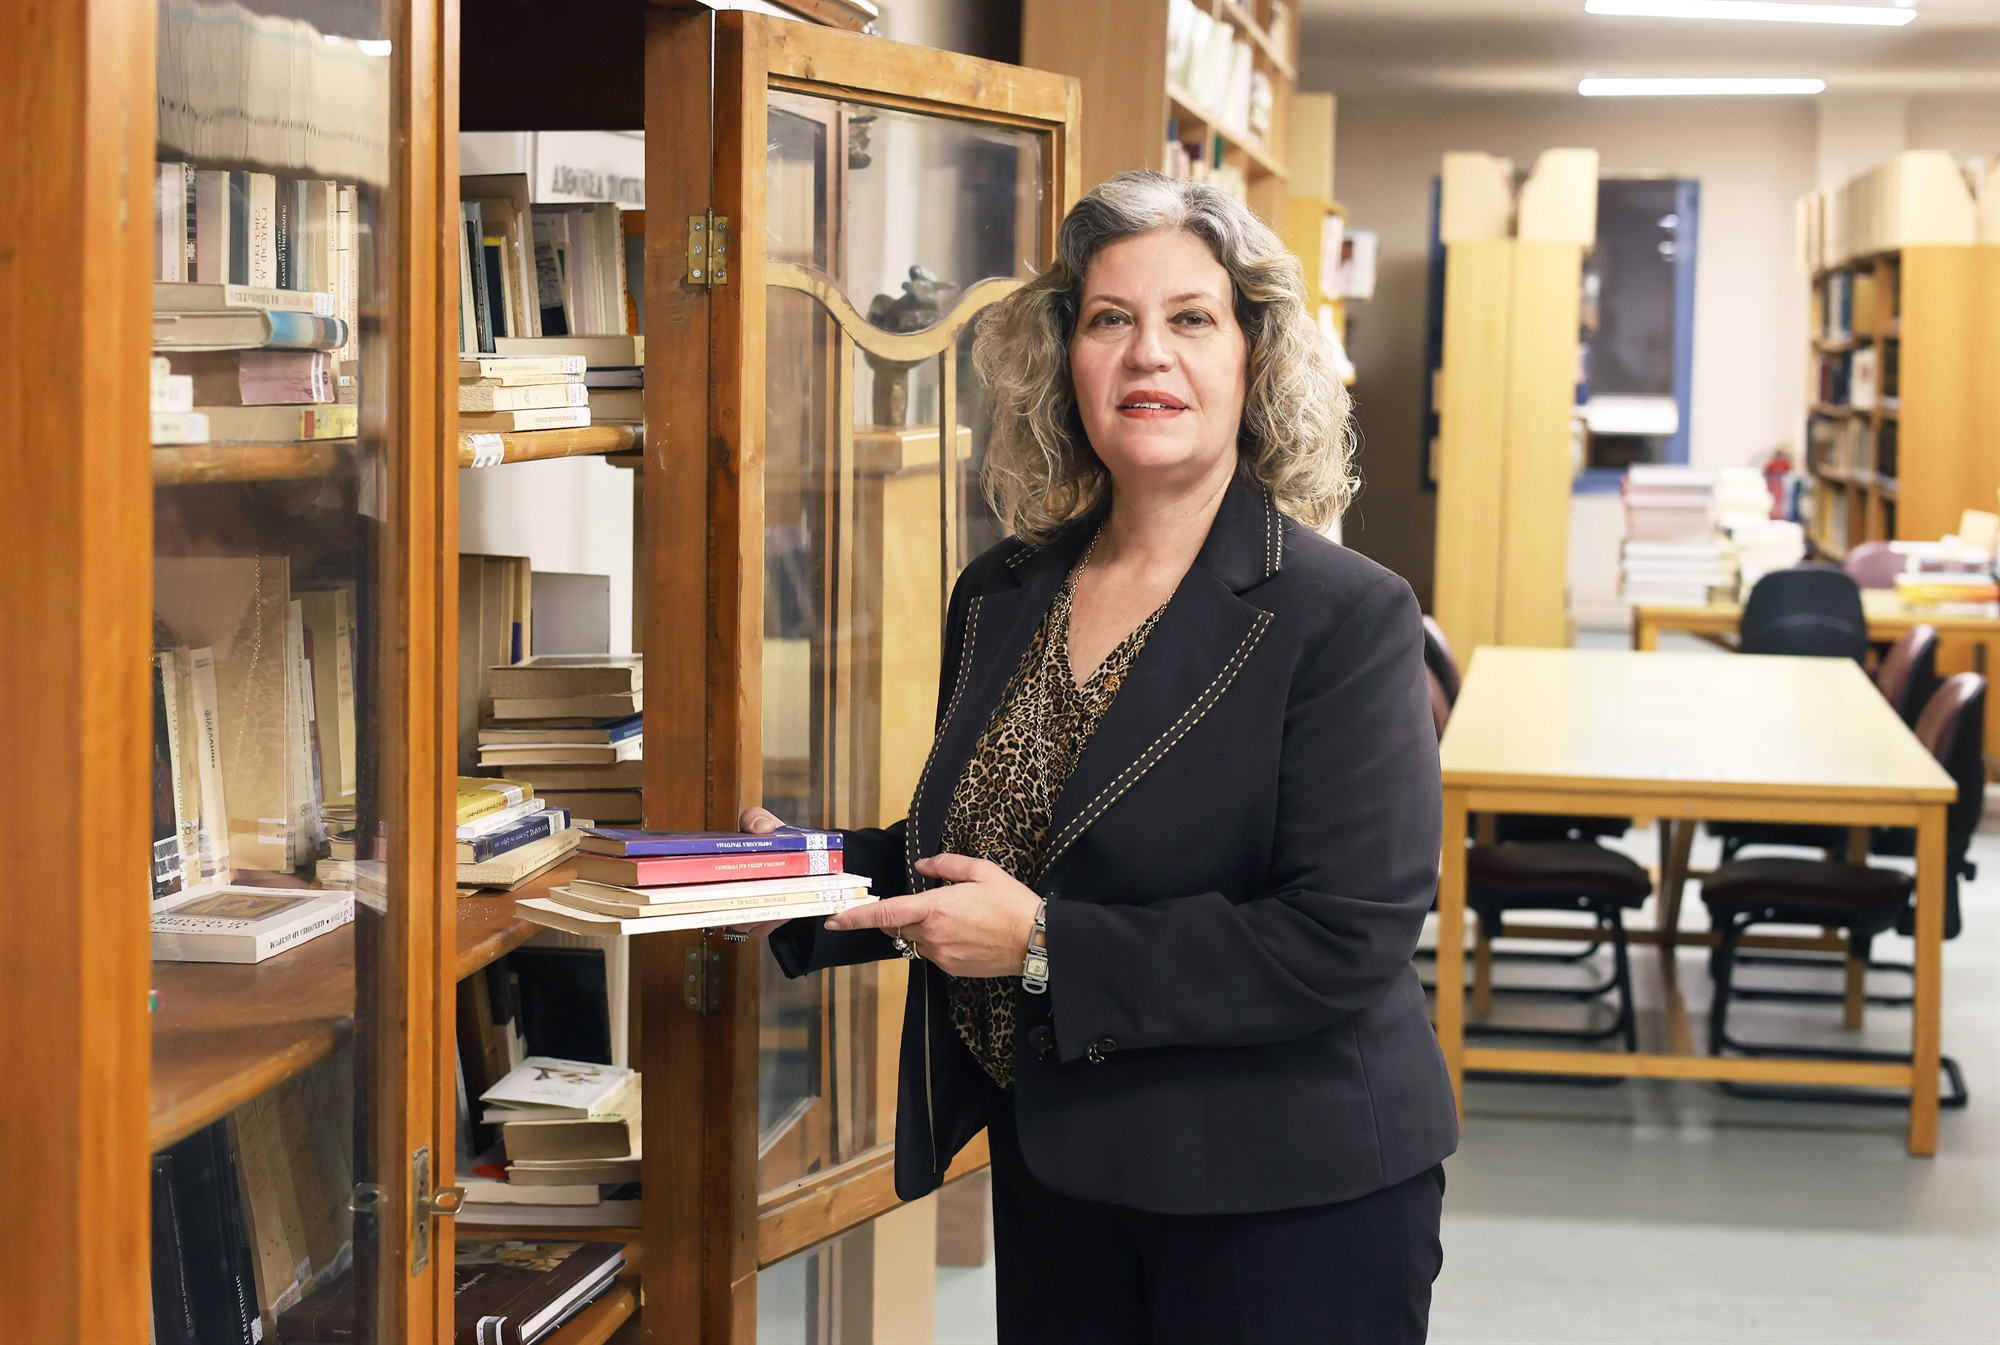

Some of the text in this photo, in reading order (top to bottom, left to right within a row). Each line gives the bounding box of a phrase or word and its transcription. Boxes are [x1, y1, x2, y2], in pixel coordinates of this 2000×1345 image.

[260, 206, 268, 262] ΦΟΥΚΩ
[737, 897, 759, 906] ΤΣΙΡΚΑΣ
[763, 895, 786, 904] ΣΤΡΑΤΗΣ
[292, 931, 299, 939] AD
